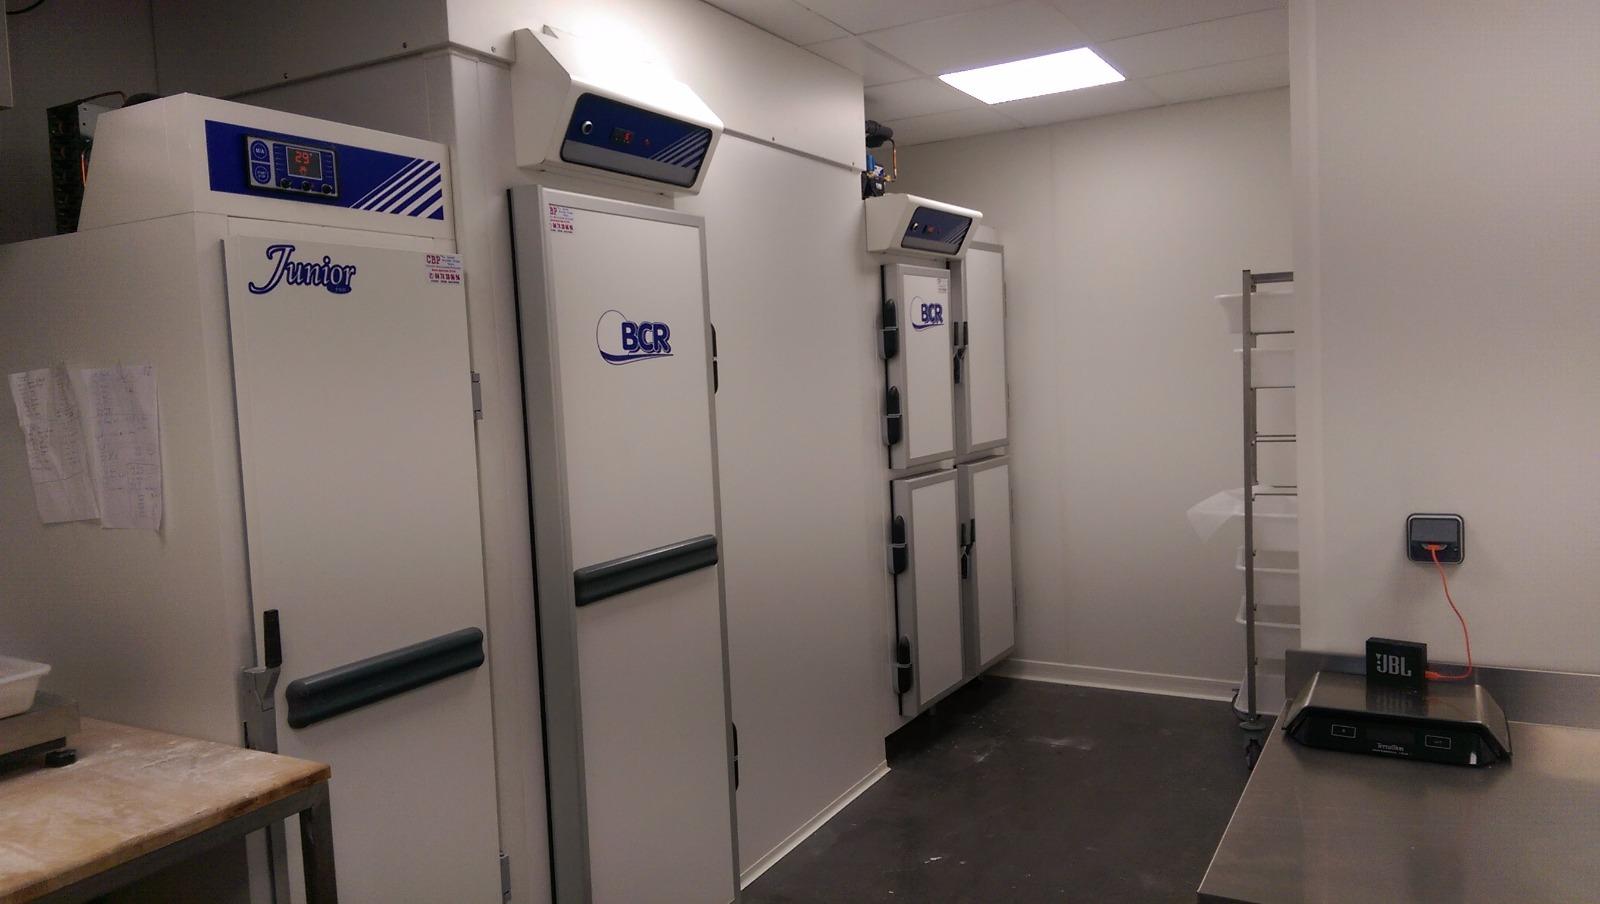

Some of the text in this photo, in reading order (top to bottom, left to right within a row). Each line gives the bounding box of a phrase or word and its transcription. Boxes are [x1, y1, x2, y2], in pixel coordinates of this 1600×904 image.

[248, 244, 356, 295] Junior
[426, 254, 441, 265] CBP
[921, 303, 944, 324] BCR
[621, 321, 672, 354] BCR
